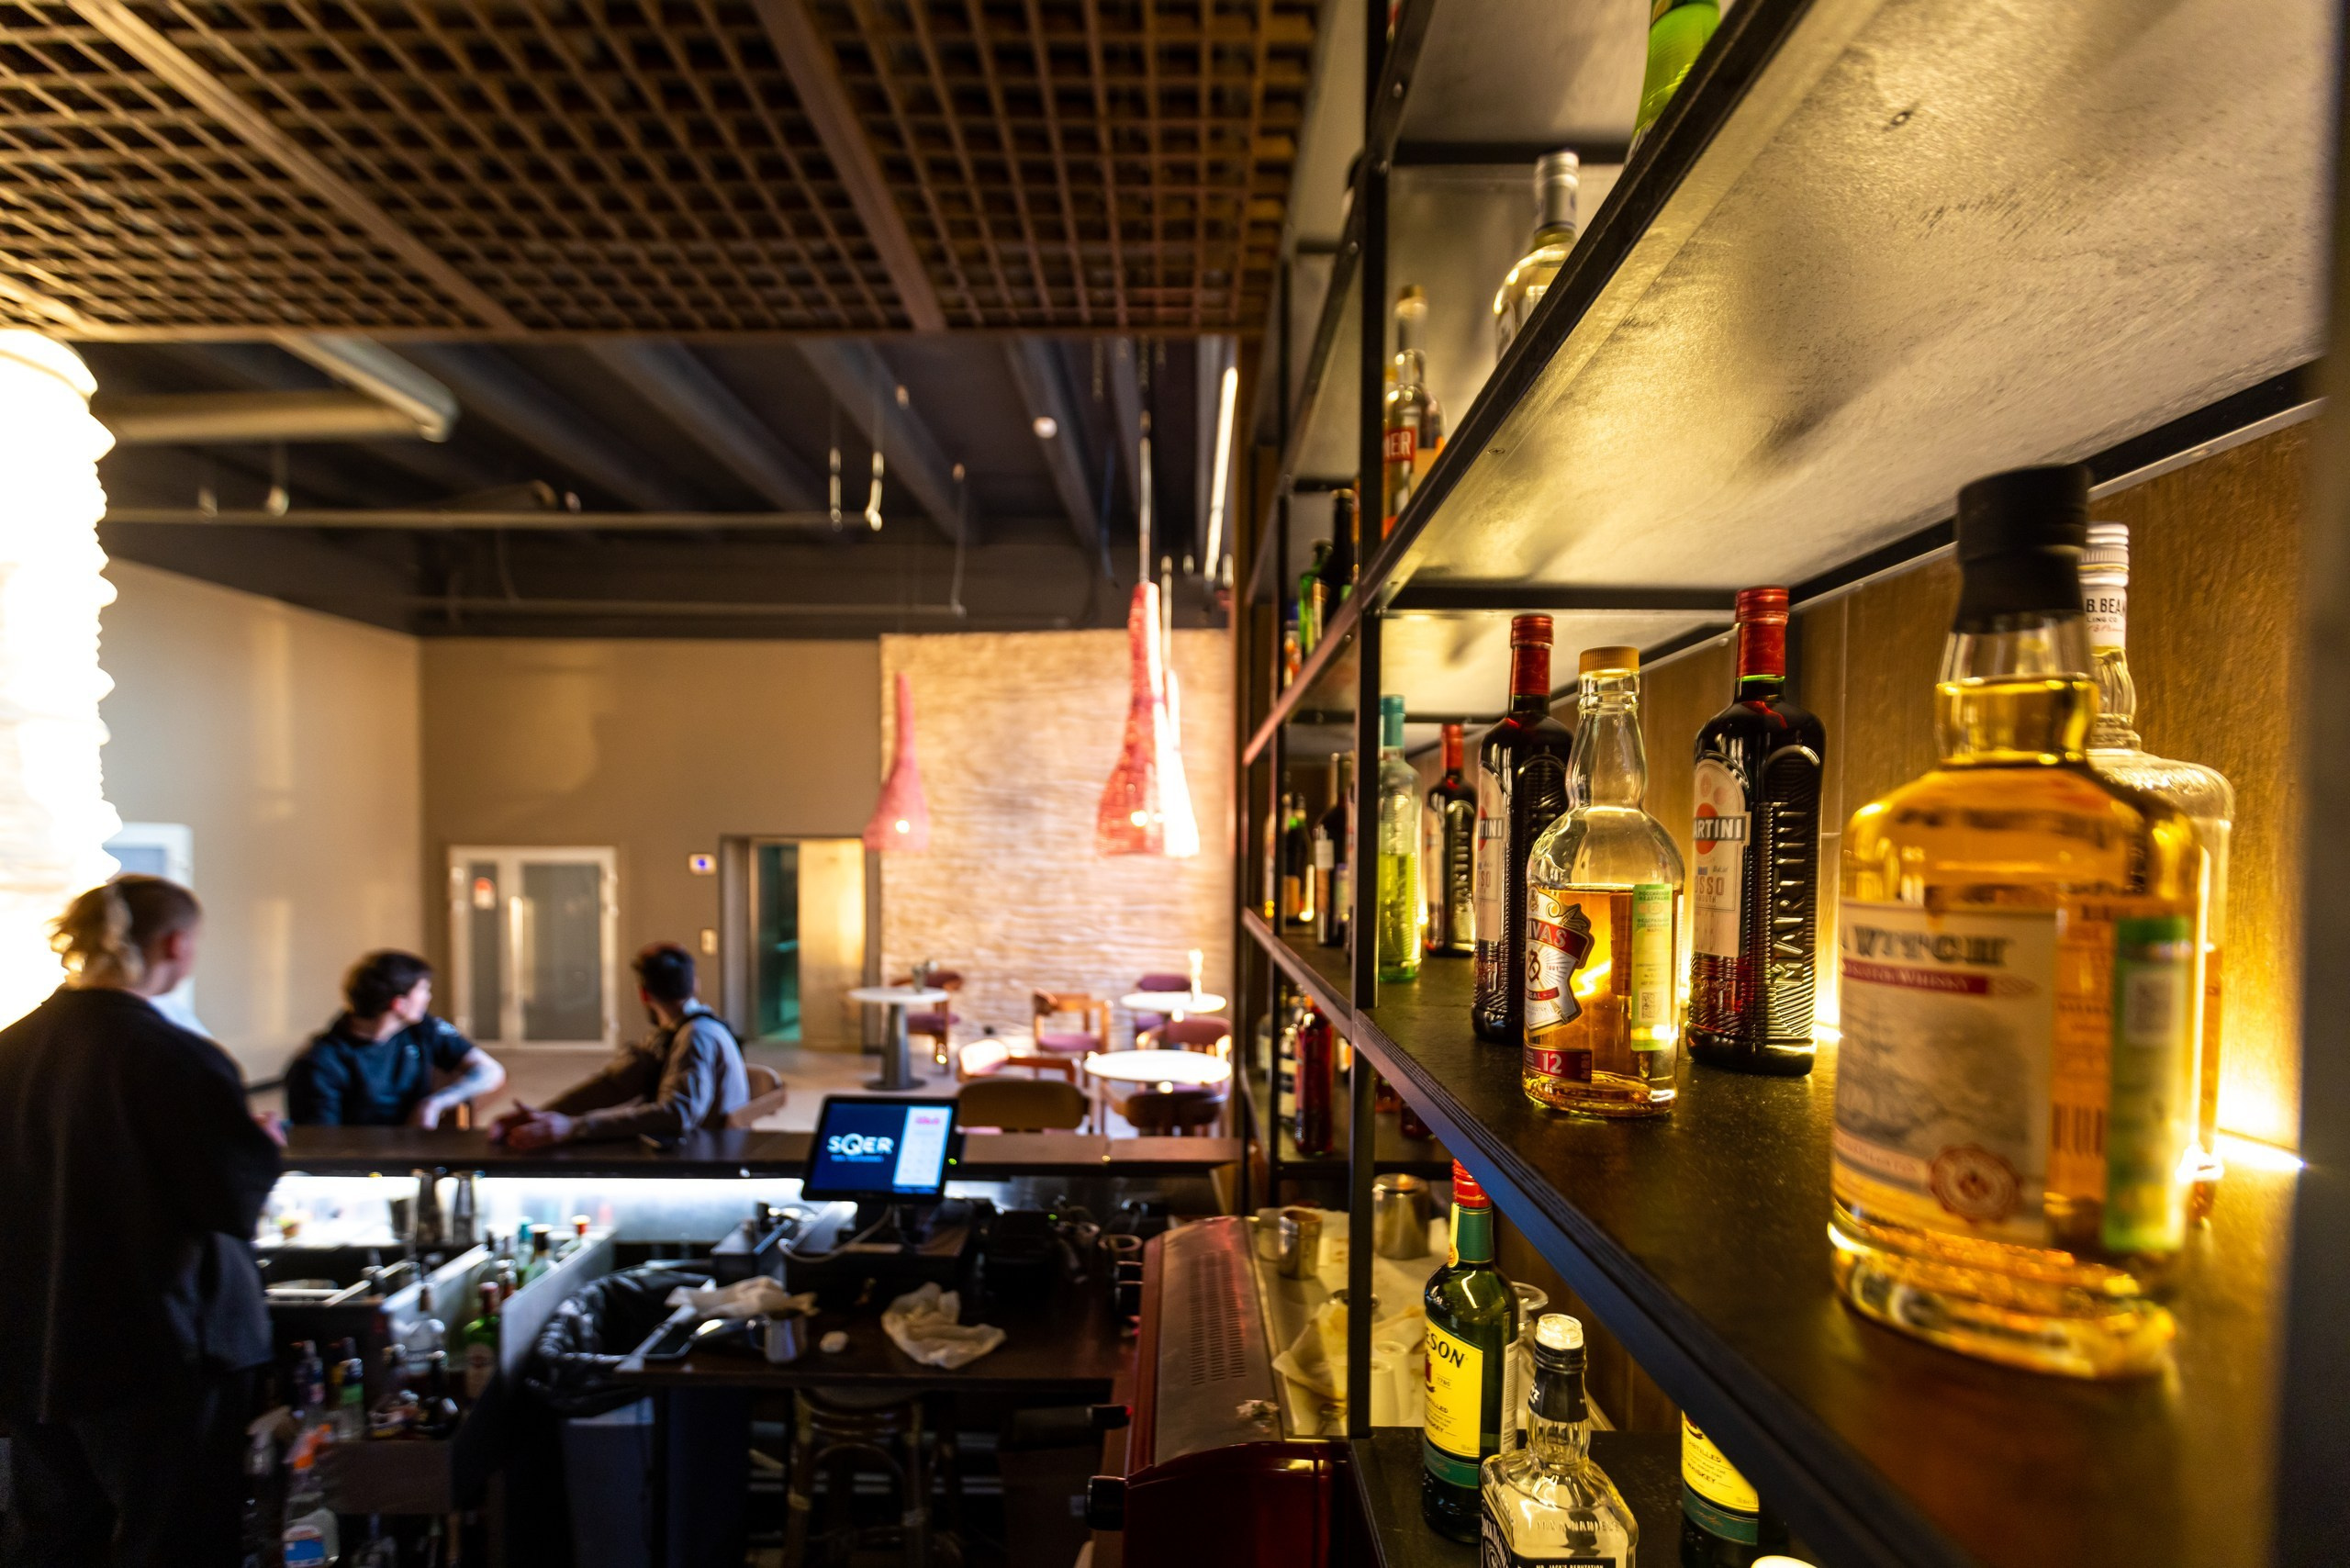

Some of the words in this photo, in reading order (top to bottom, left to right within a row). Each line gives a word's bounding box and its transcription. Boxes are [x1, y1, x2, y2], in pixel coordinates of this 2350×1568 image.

[1772, 812, 1806, 985] MARTINI
[1542, 1052, 1562, 1074] 12
[826, 1133, 894, 1156] SQER
